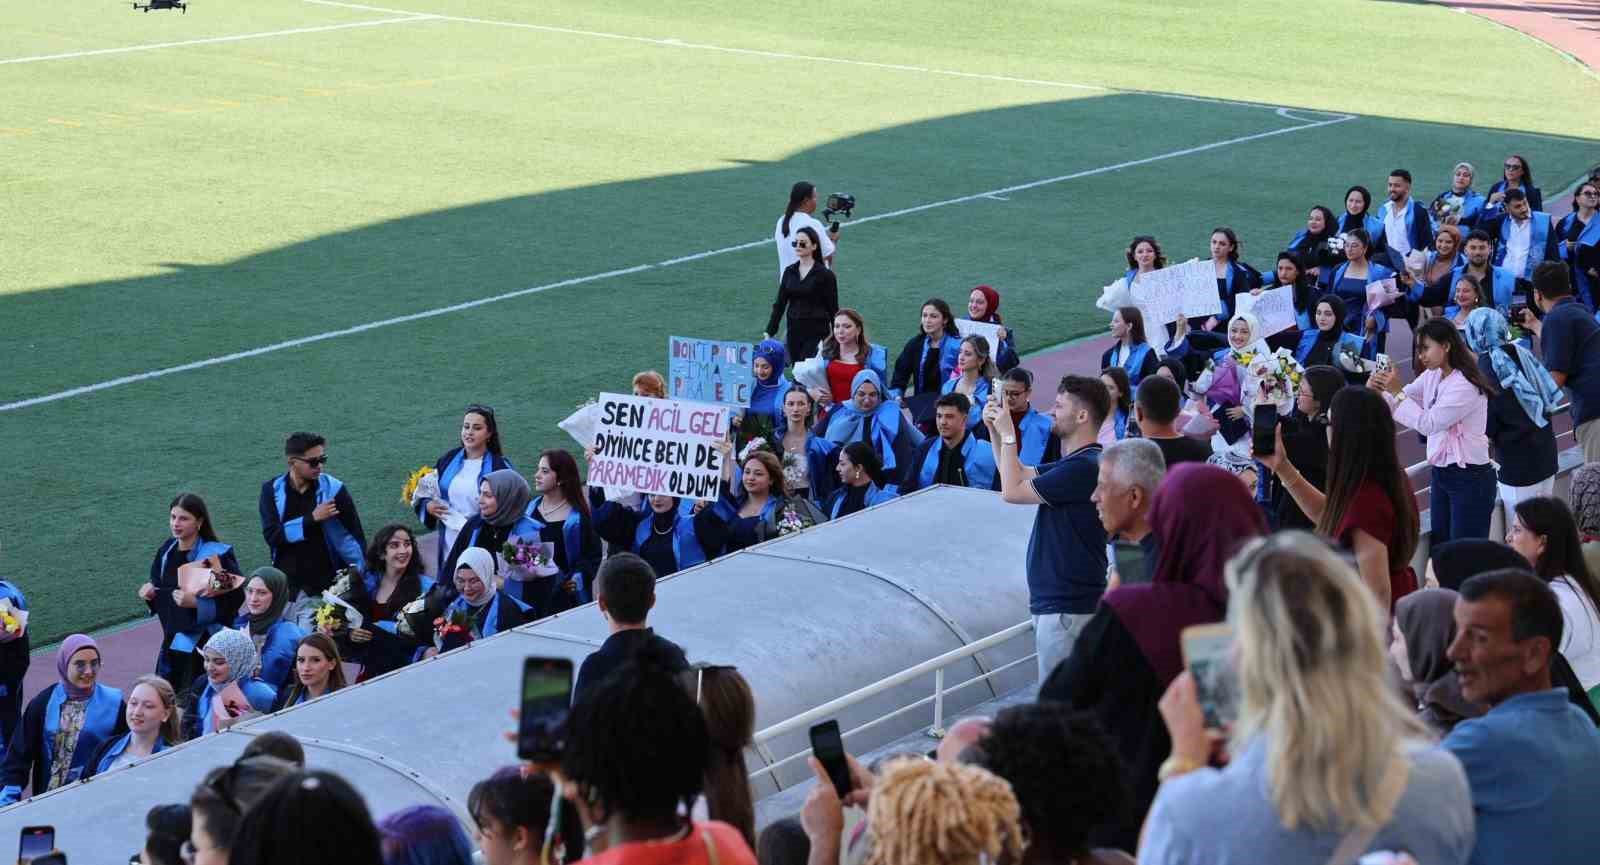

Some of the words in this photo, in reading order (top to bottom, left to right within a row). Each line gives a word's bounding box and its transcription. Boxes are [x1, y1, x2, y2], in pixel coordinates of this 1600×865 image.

[601, 401, 645, 428] SEN
[594, 429, 653, 462] DİYİNCE
[655, 439, 689, 466] BEN
[694, 443, 720, 470] DE
[590, 459, 668, 491] PARAMEDİK
[668, 471, 718, 498] OLDUM
